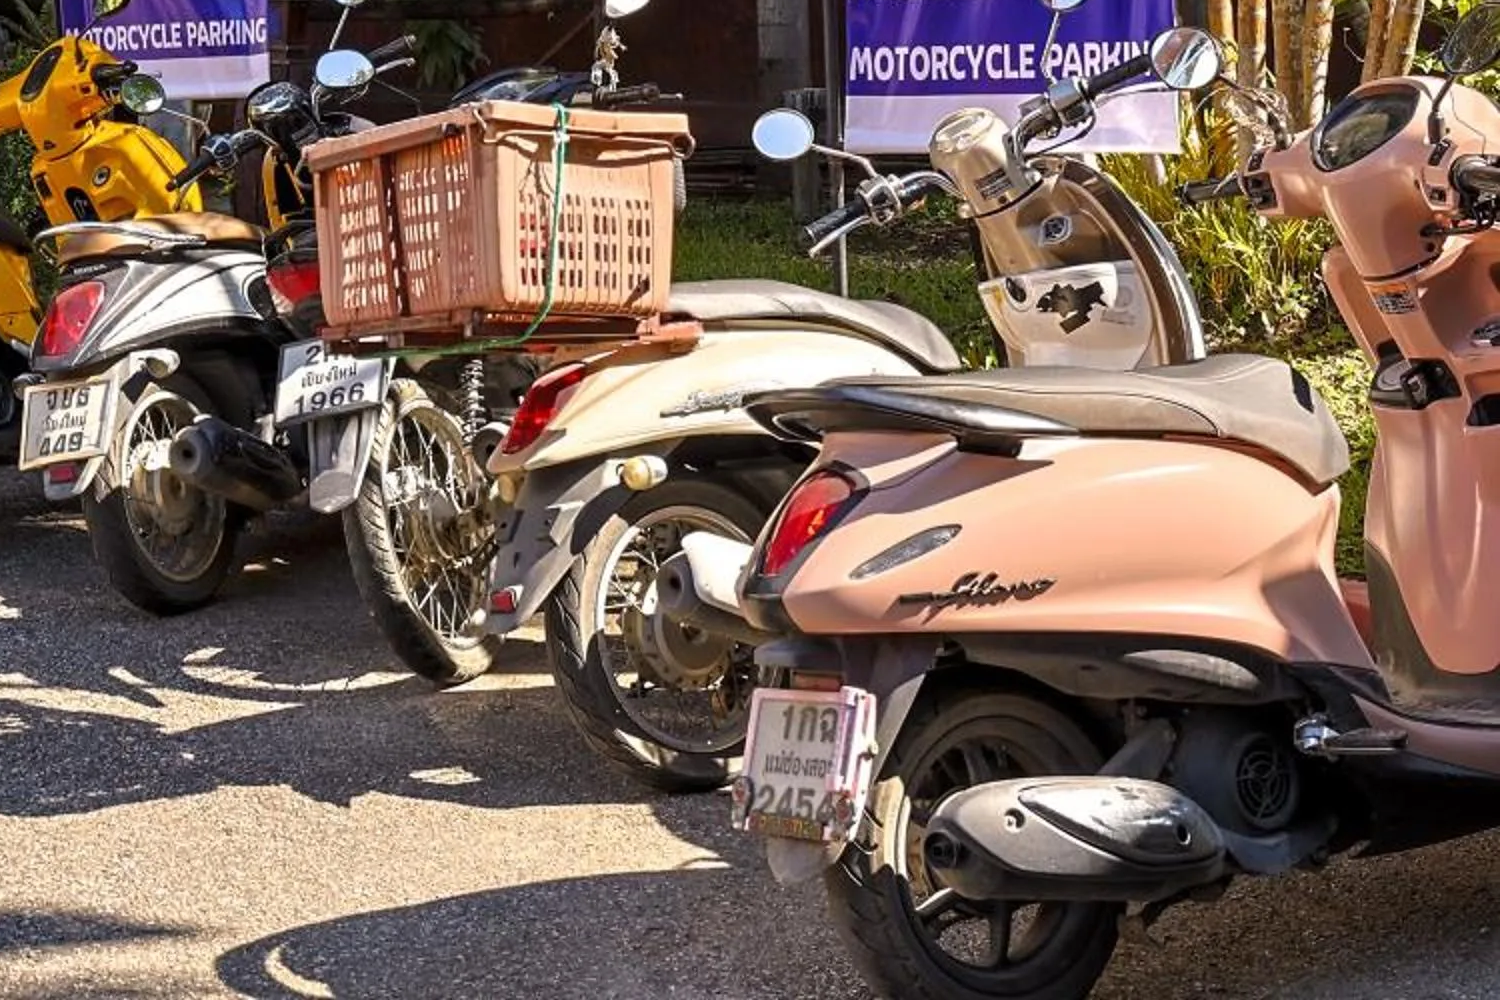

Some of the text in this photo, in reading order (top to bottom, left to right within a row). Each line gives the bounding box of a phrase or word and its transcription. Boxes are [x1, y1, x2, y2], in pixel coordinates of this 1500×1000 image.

[186, 17, 267, 49] PARKING
[850, 41, 1152, 81] MOTORCYCLE PARKIN
[294, 381, 365, 415] 1966
[40, 431, 84, 457] 449
